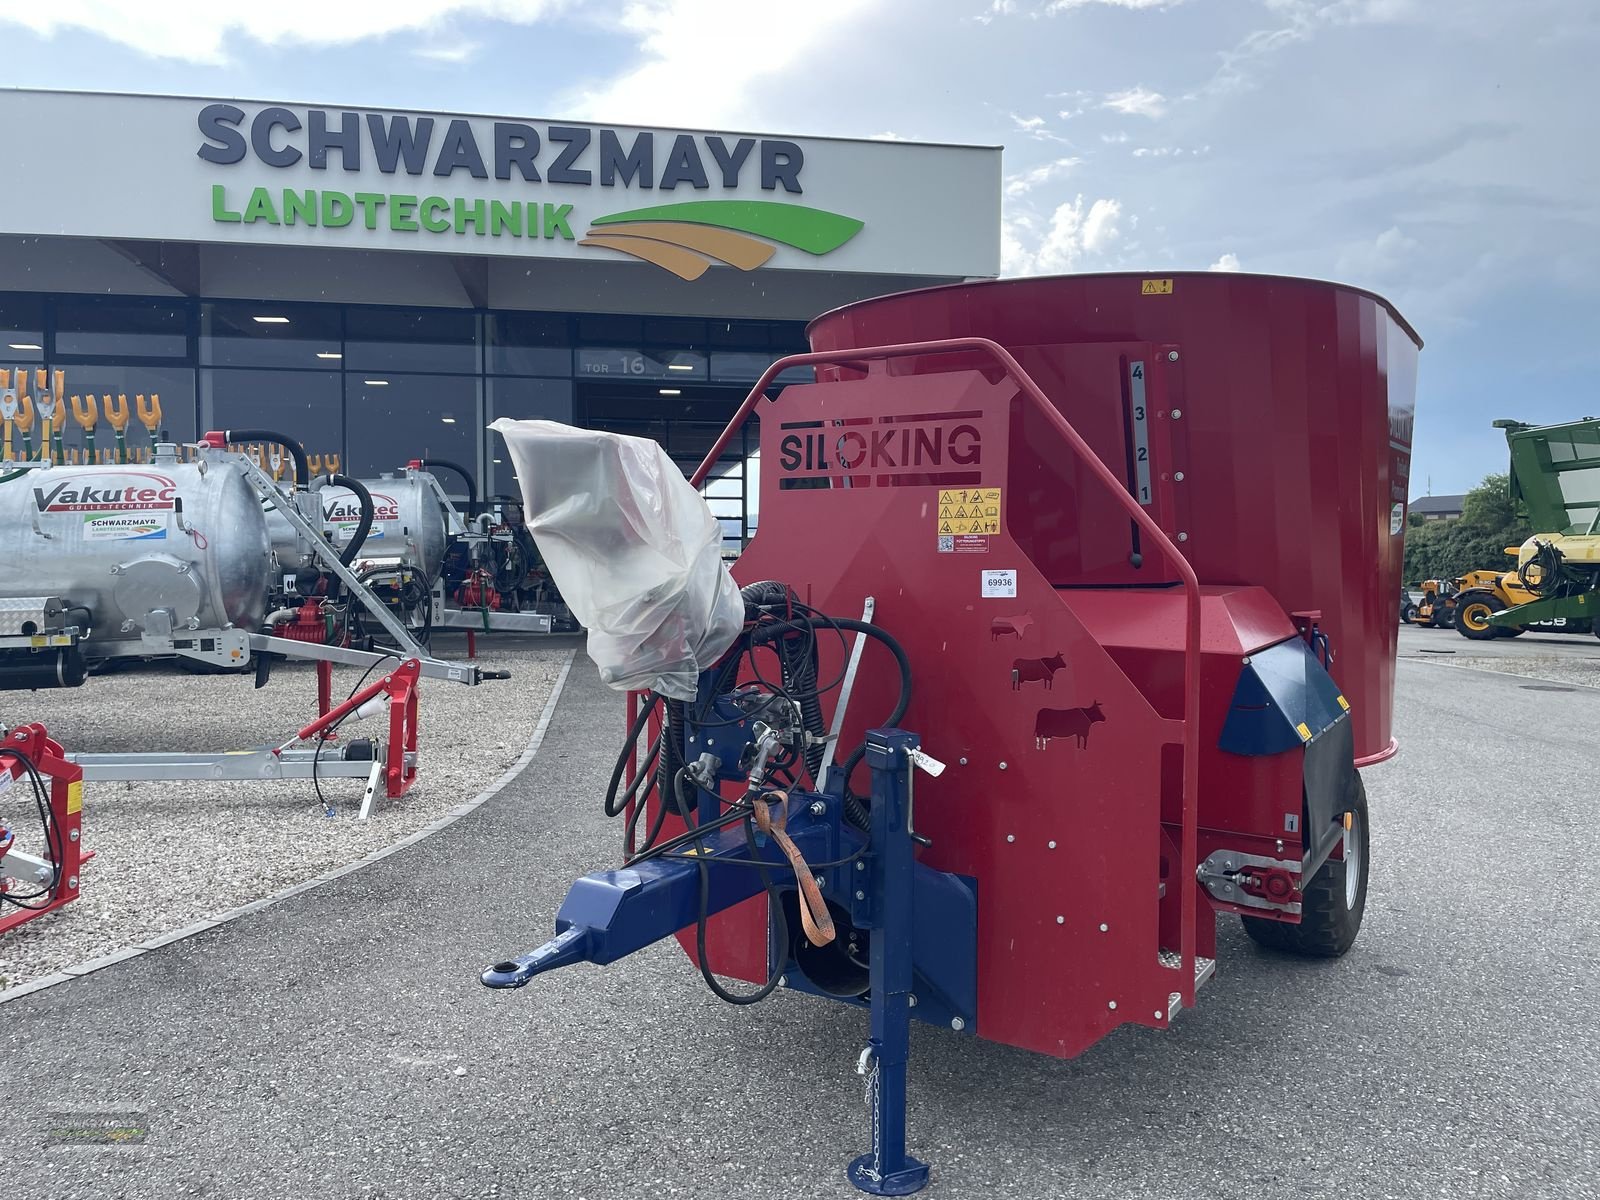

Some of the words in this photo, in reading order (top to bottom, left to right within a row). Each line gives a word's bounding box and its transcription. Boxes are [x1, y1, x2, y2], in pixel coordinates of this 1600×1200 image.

[197, 103, 804, 193] SCHWARZMAYR
[212, 184, 575, 240] LANDTECHNIK
[585, 363, 609, 373] TOR
[621, 356, 645, 374] 16
[1132, 365, 1143, 379] 4
[1135, 406, 1145, 420] 3
[780, 424, 981, 471] SILOKING
[1137, 447, 1148, 461] 2
[33, 482, 176, 512] Vakutec
[1141, 486, 1148, 500] 1
[91, 519, 156, 527] SCHWARZMAYR
[988, 578, 1012, 586] 69936
